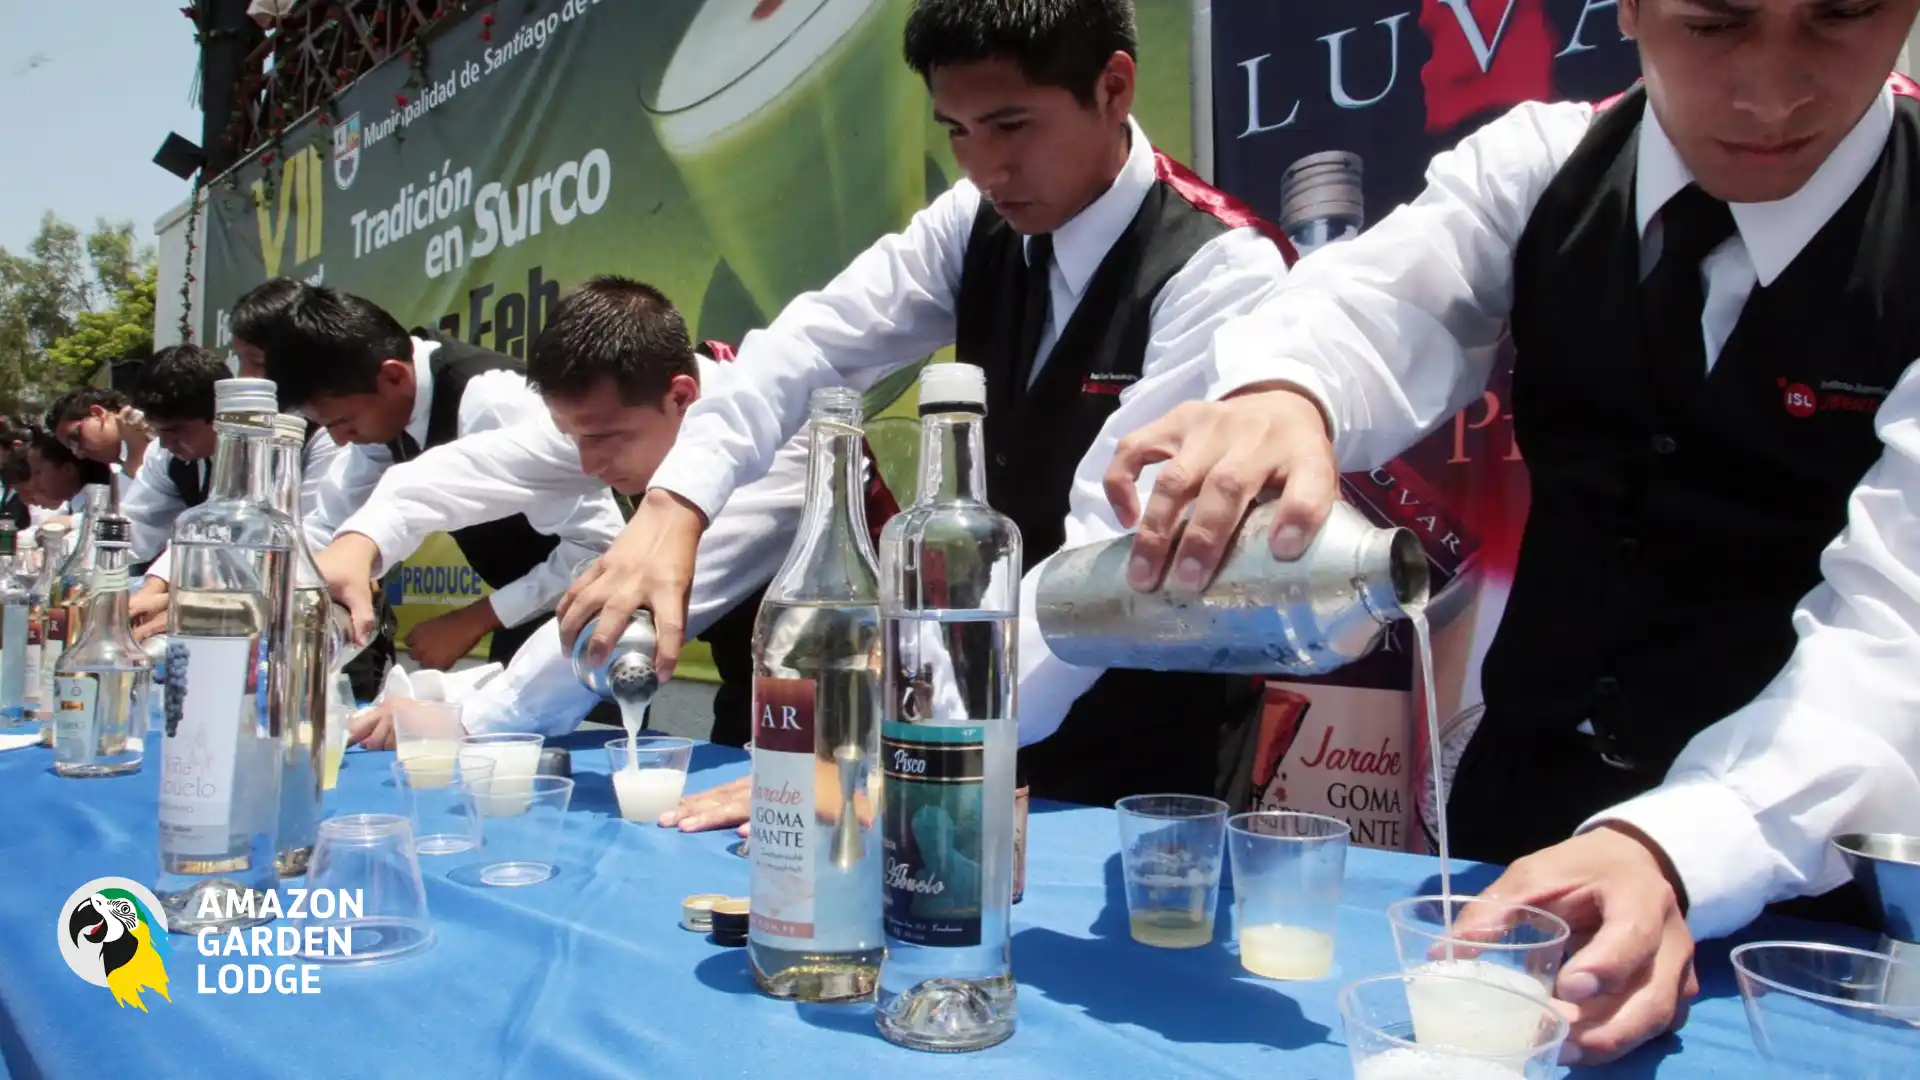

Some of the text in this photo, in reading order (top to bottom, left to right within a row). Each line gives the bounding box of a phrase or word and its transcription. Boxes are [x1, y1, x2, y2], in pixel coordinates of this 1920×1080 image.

[460, 60, 480, 90] de
[484, 12, 559, 76] Santiago
[351, 159, 473, 259] Tradición
[425, 148, 611, 278] en Surco
[1787, 392, 1813, 408] ISL
[894, 749, 926, 774] Pisco
[1300, 726, 1402, 776] Jarabe
[755, 806, 804, 829] GOMA
[1327, 782, 1402, 814] GOMA
